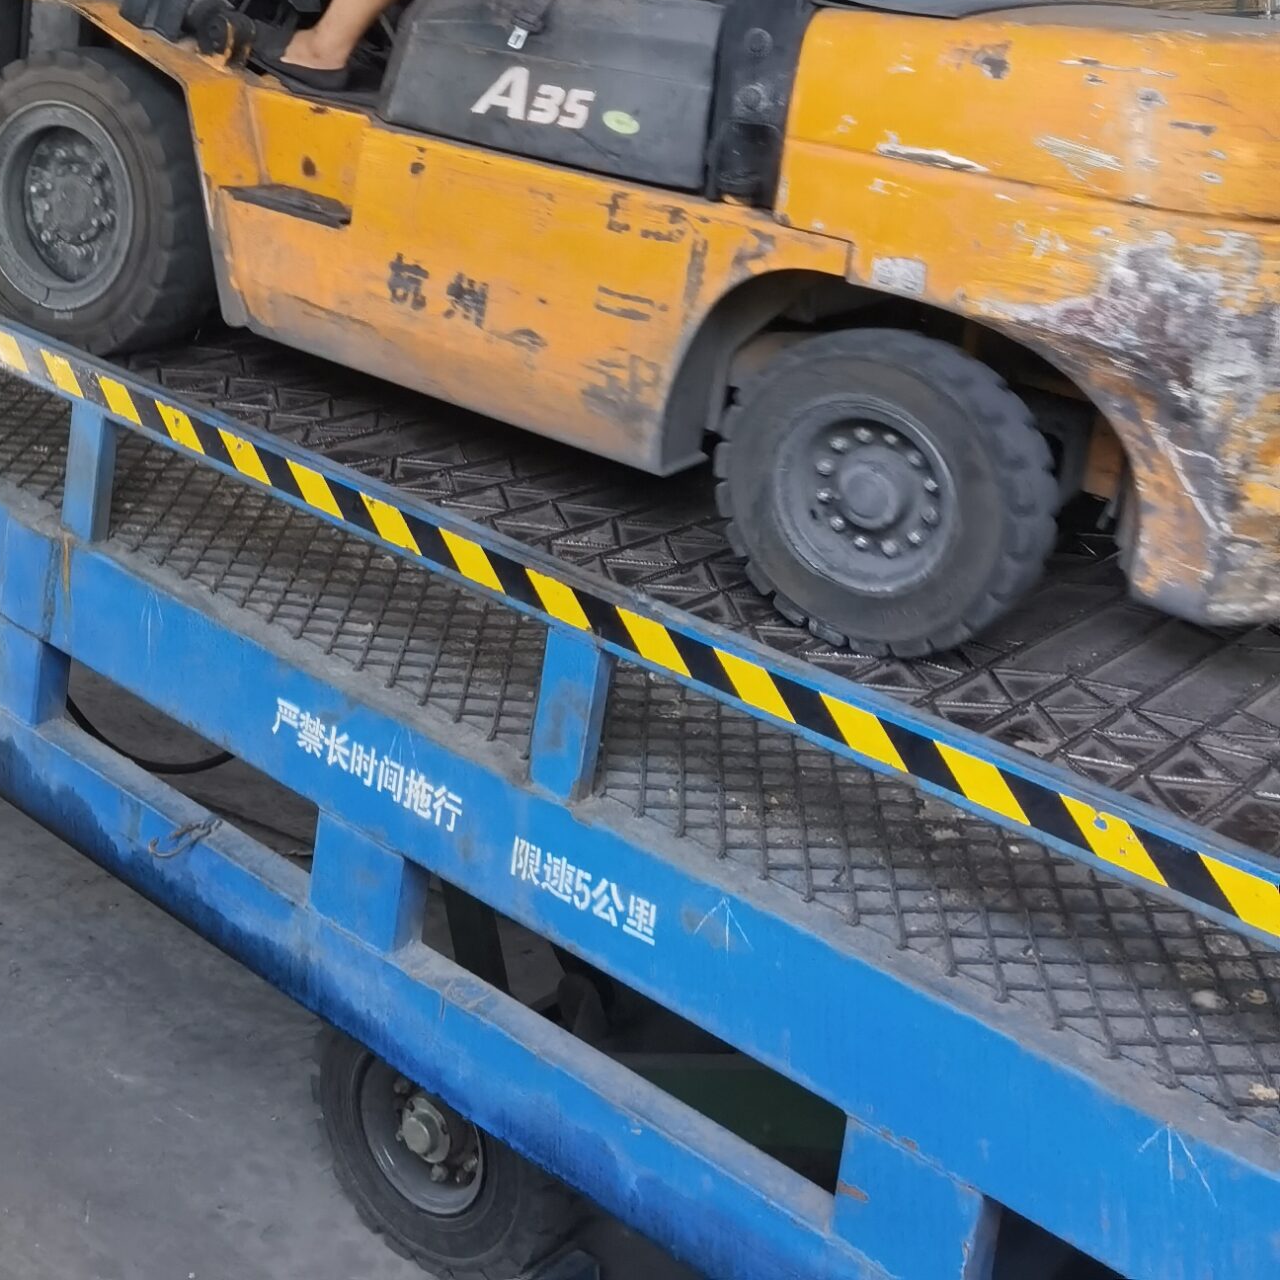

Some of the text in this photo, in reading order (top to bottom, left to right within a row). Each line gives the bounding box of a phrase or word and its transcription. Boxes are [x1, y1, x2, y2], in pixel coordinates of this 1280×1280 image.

[471, 66, 596, 129] A35
[272, 697, 463, 832] 严禁长时间拖行
[510, 835, 656, 946] 限速5公里
